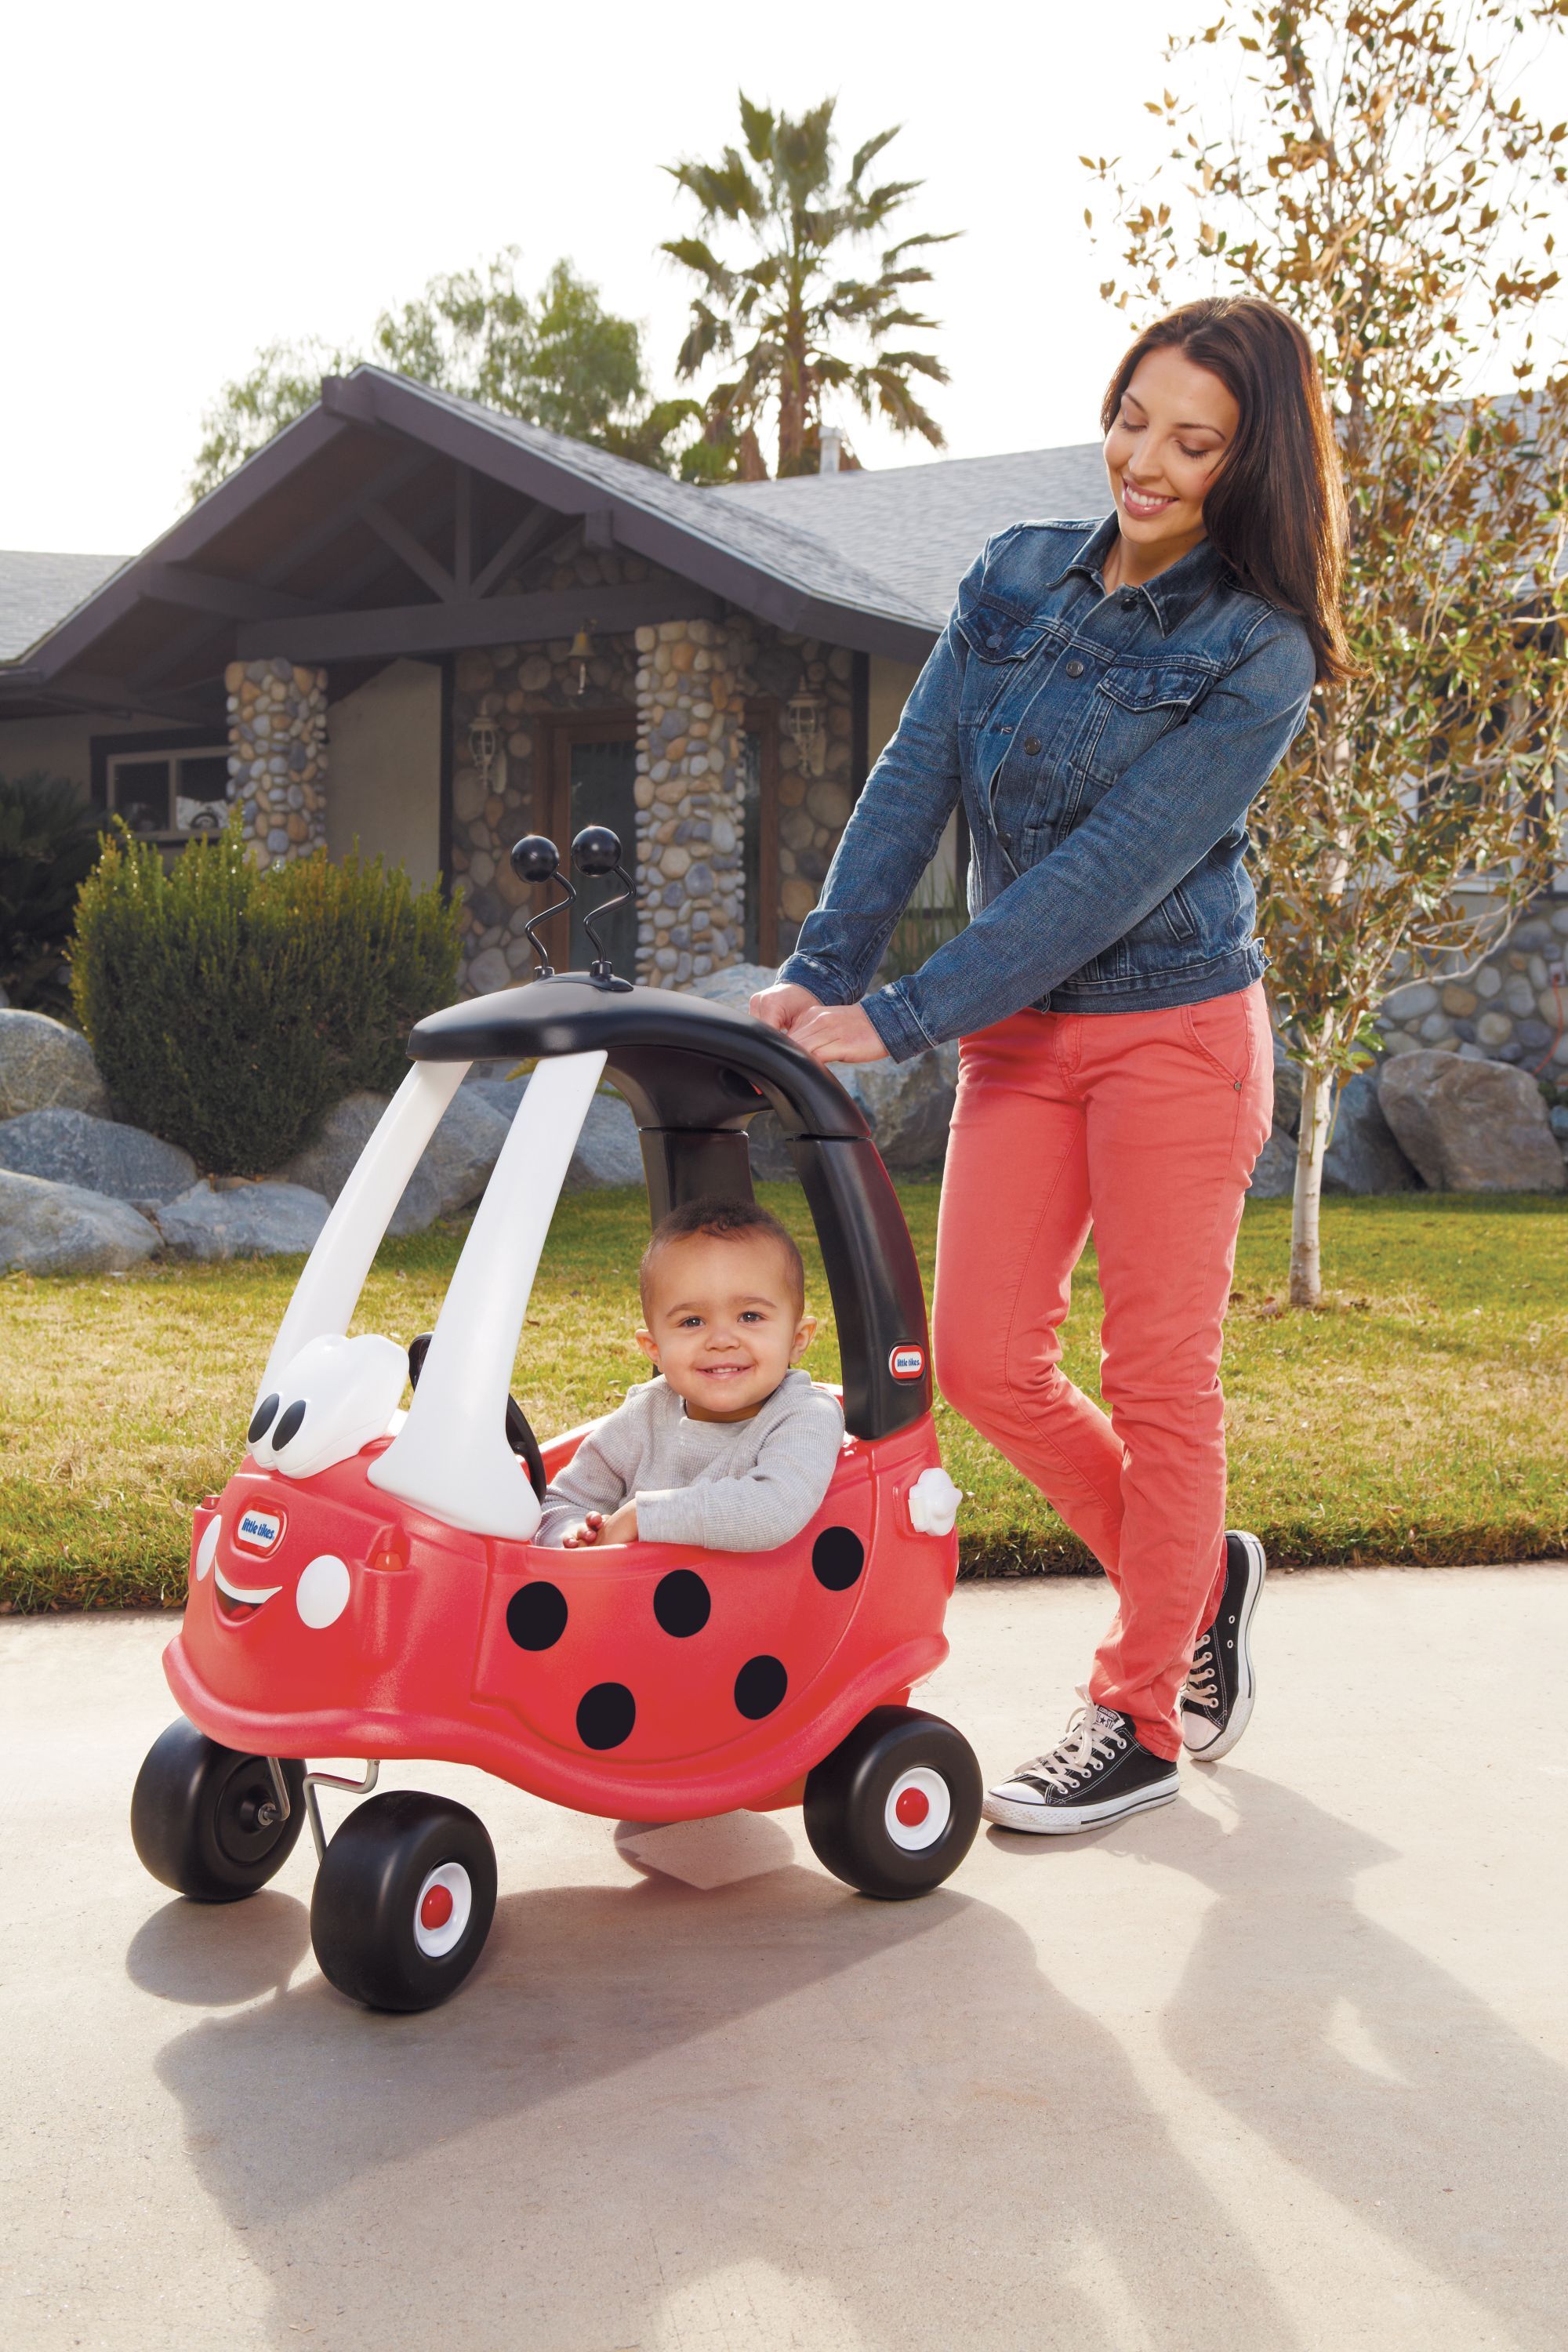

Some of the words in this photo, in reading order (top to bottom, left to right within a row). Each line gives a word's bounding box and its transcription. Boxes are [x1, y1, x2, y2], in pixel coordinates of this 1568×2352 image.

[897, 1358, 908, 1367] little
[241, 1518, 258, 1534] little
[257, 1523, 274, 1540] tikes
